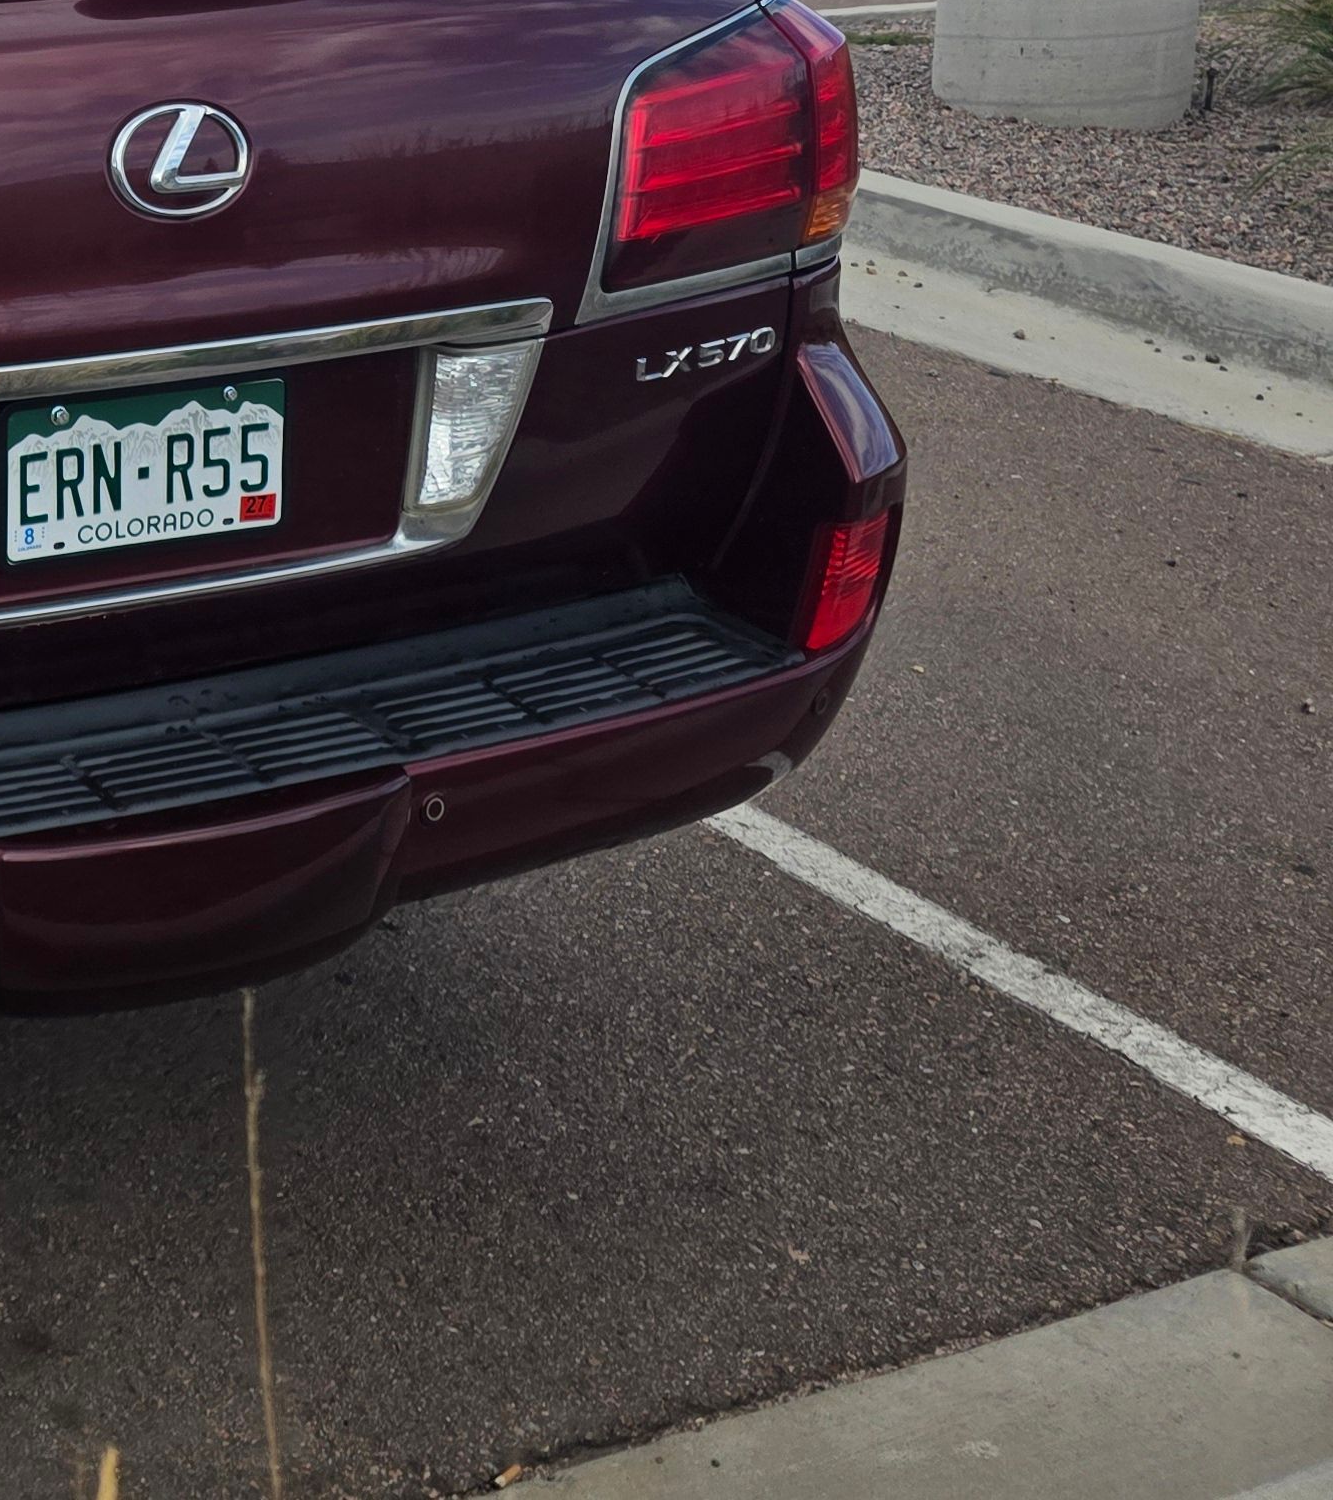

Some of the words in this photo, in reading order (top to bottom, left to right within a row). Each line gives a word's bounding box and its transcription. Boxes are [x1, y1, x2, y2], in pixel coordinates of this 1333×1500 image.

[245, 495, 267, 514] 27
[77, 508, 215, 544] COLORADO
[24, 527, 35, 545] 8
